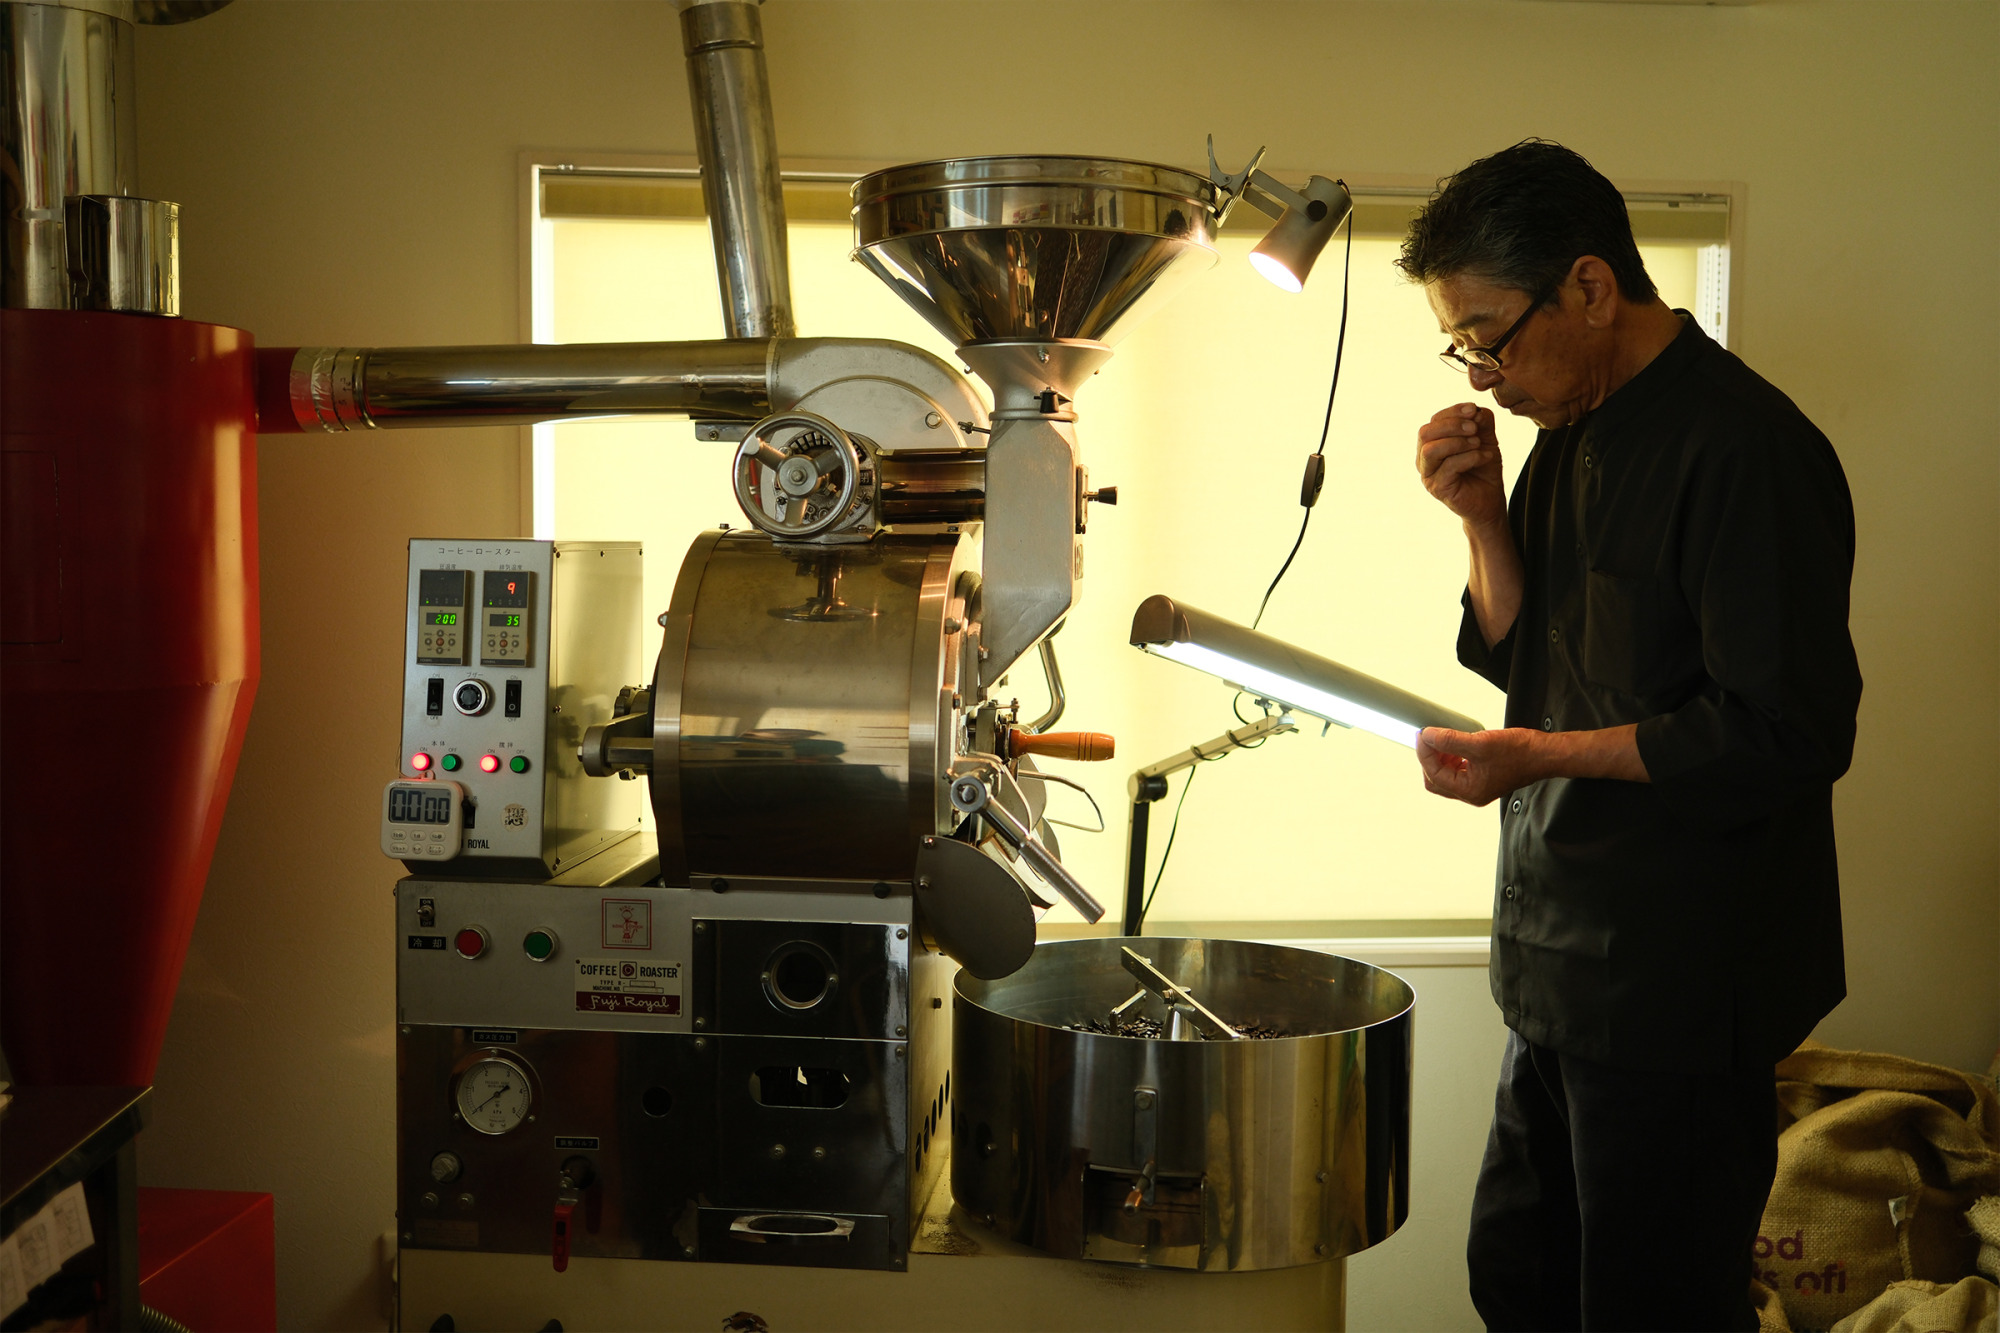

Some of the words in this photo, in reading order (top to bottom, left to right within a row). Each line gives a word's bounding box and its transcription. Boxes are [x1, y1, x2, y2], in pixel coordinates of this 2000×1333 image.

[438, 547, 521, 555] コーヒーロースター
[435, 614, 456, 625] 200
[506, 615, 520, 626] 35
[467, 839, 490, 849] ROYAL
[412, 938, 443, 949] 冷却
[580, 964, 617, 976] COFFEE
[640, 966, 678, 978] ROASTER
[588, 995, 620, 1011] Fuji
[624, 996, 669, 1012] Royal
[1795, 1261, 1846, 1295] ofi
